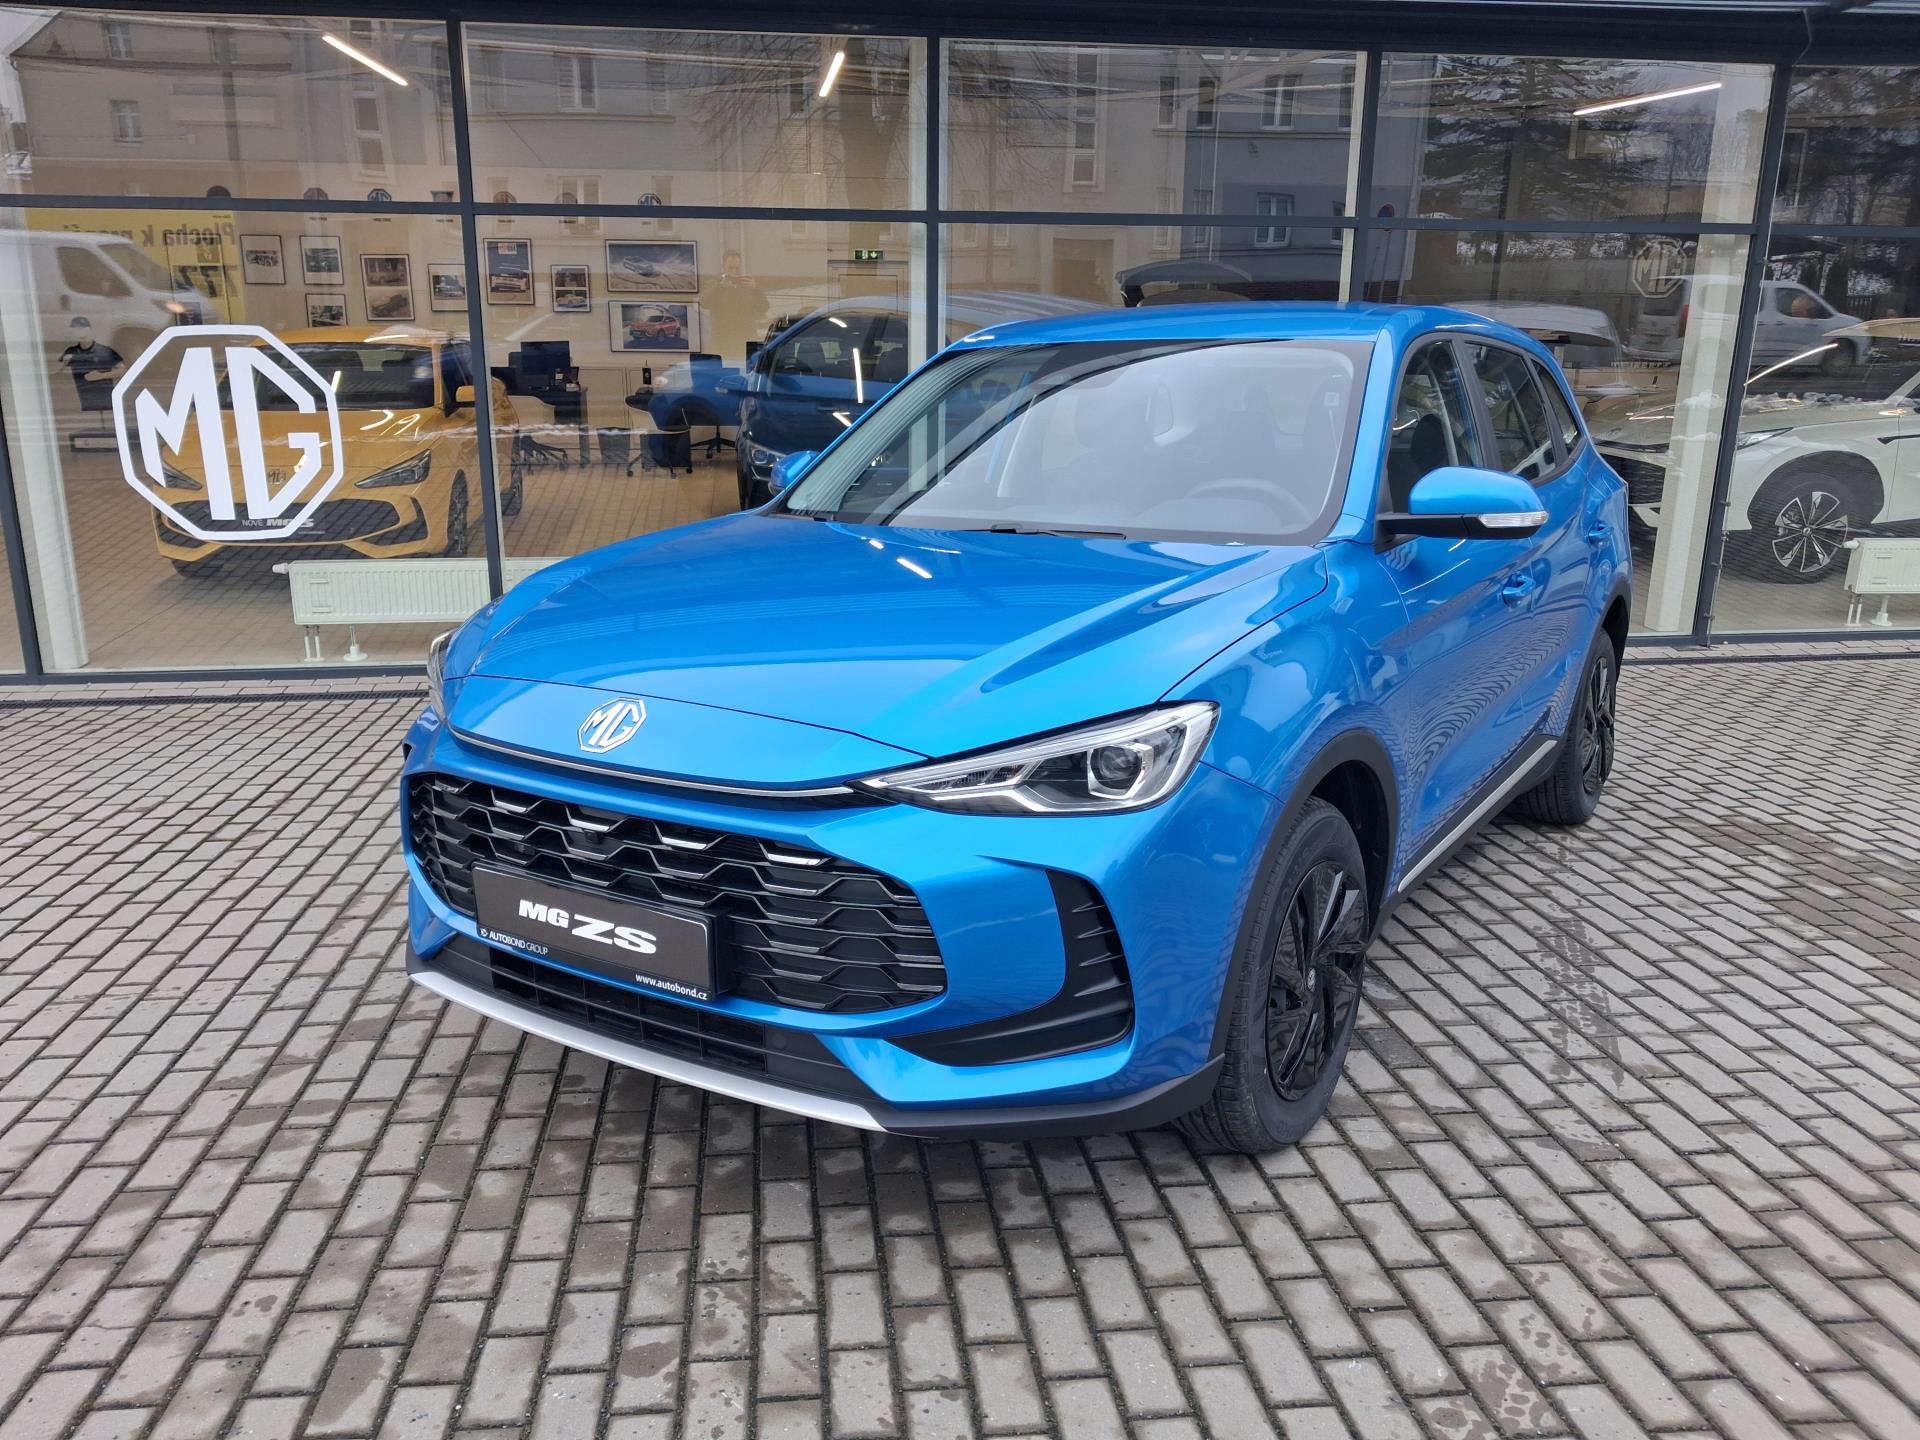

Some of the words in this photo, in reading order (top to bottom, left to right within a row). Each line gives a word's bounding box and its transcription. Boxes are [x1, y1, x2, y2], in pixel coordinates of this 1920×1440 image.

[1635, 243, 1681, 293] MG
[134, 346, 323, 521] MG
[583, 701, 641, 748] MG
[489, 930, 526, 949] AUTOBOND
[525, 942, 549, 955] GROUP
[518, 899, 570, 929] MG
[571, 914, 657, 955] ZS
[635, 974, 708, 1001] www.autobond.cz
